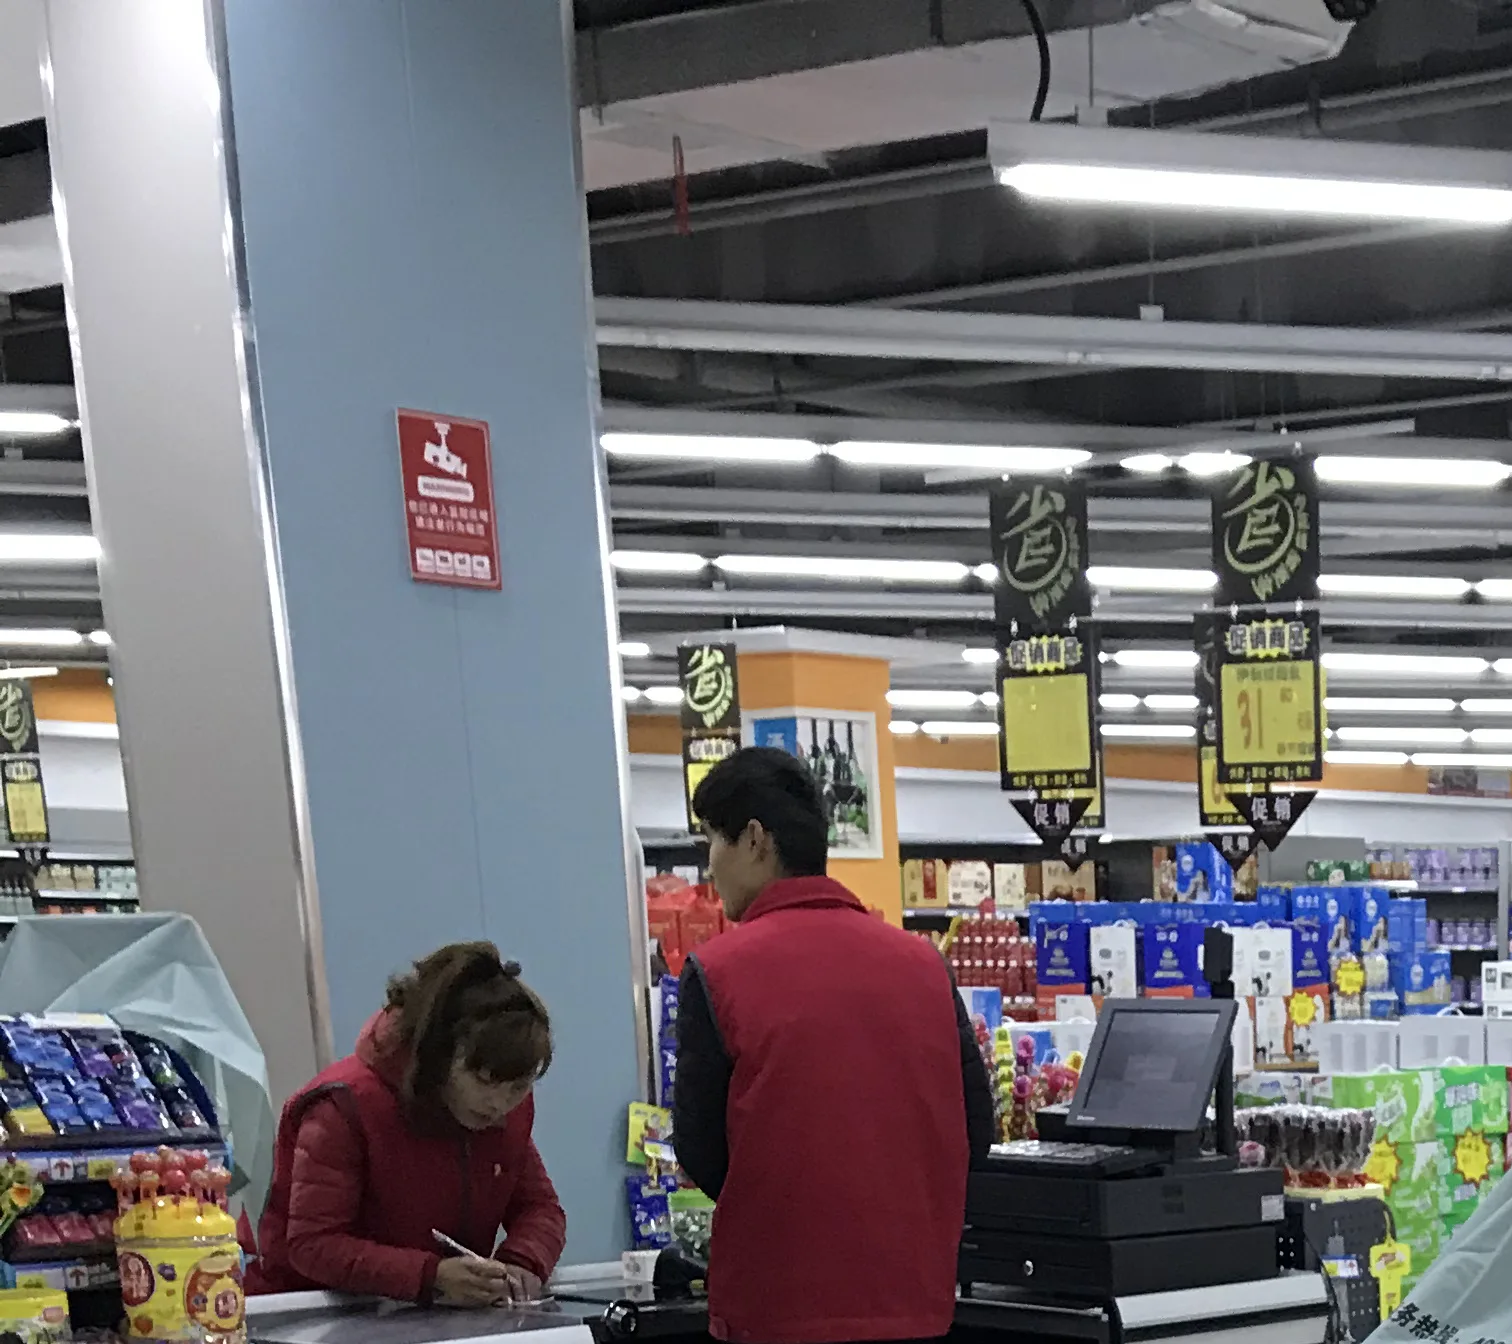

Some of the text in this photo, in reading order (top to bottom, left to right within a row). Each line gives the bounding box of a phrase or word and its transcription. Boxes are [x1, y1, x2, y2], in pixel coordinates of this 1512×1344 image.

[1229, 621, 1306, 655] 促销商品
[1034, 802, 1070, 826] 促销
[1252, 797, 1292, 821] 促销
